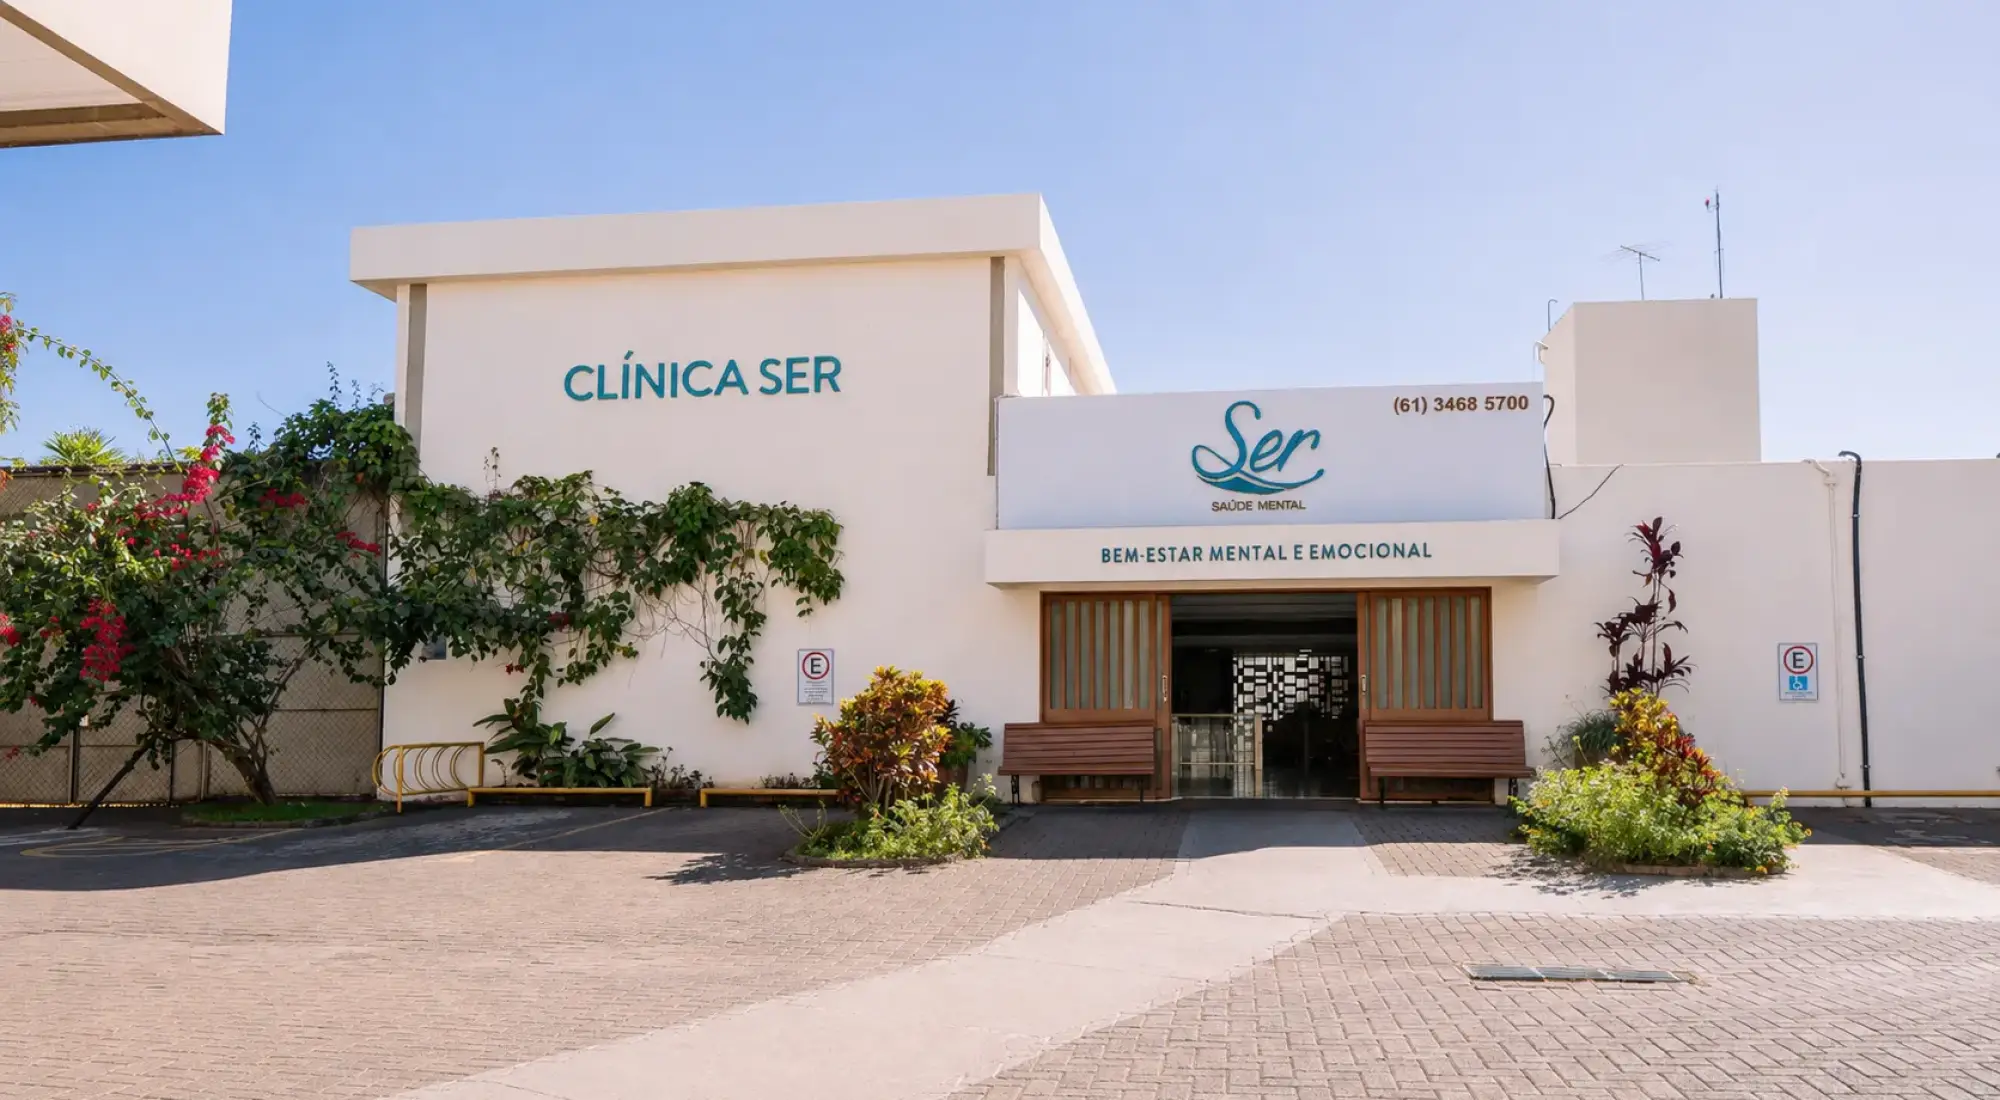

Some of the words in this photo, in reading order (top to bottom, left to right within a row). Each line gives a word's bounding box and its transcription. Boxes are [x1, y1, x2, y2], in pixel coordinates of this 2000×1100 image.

[564, 350, 749, 401] CLÍNICA
[759, 355, 841, 395] SER
[1394, 396, 1428, 415] (61)
[1433, 396, 1478, 412] 3468
[1484, 395, 1529, 411] 5700
[1192, 400, 1324, 489] Ser
[1211, 499, 1253, 512] SAÚDE
[1258, 500, 1306, 511] MENTAL
[1101, 546, 1203, 563] BEM-ESTAR
[1209, 544, 1287, 561] MENTAL
[1293, 544, 1304, 560] E
[1309, 542, 1432, 560] EMOCIONAL
[810, 657, 822, 674] E
[1792, 652, 1805, 669] E
